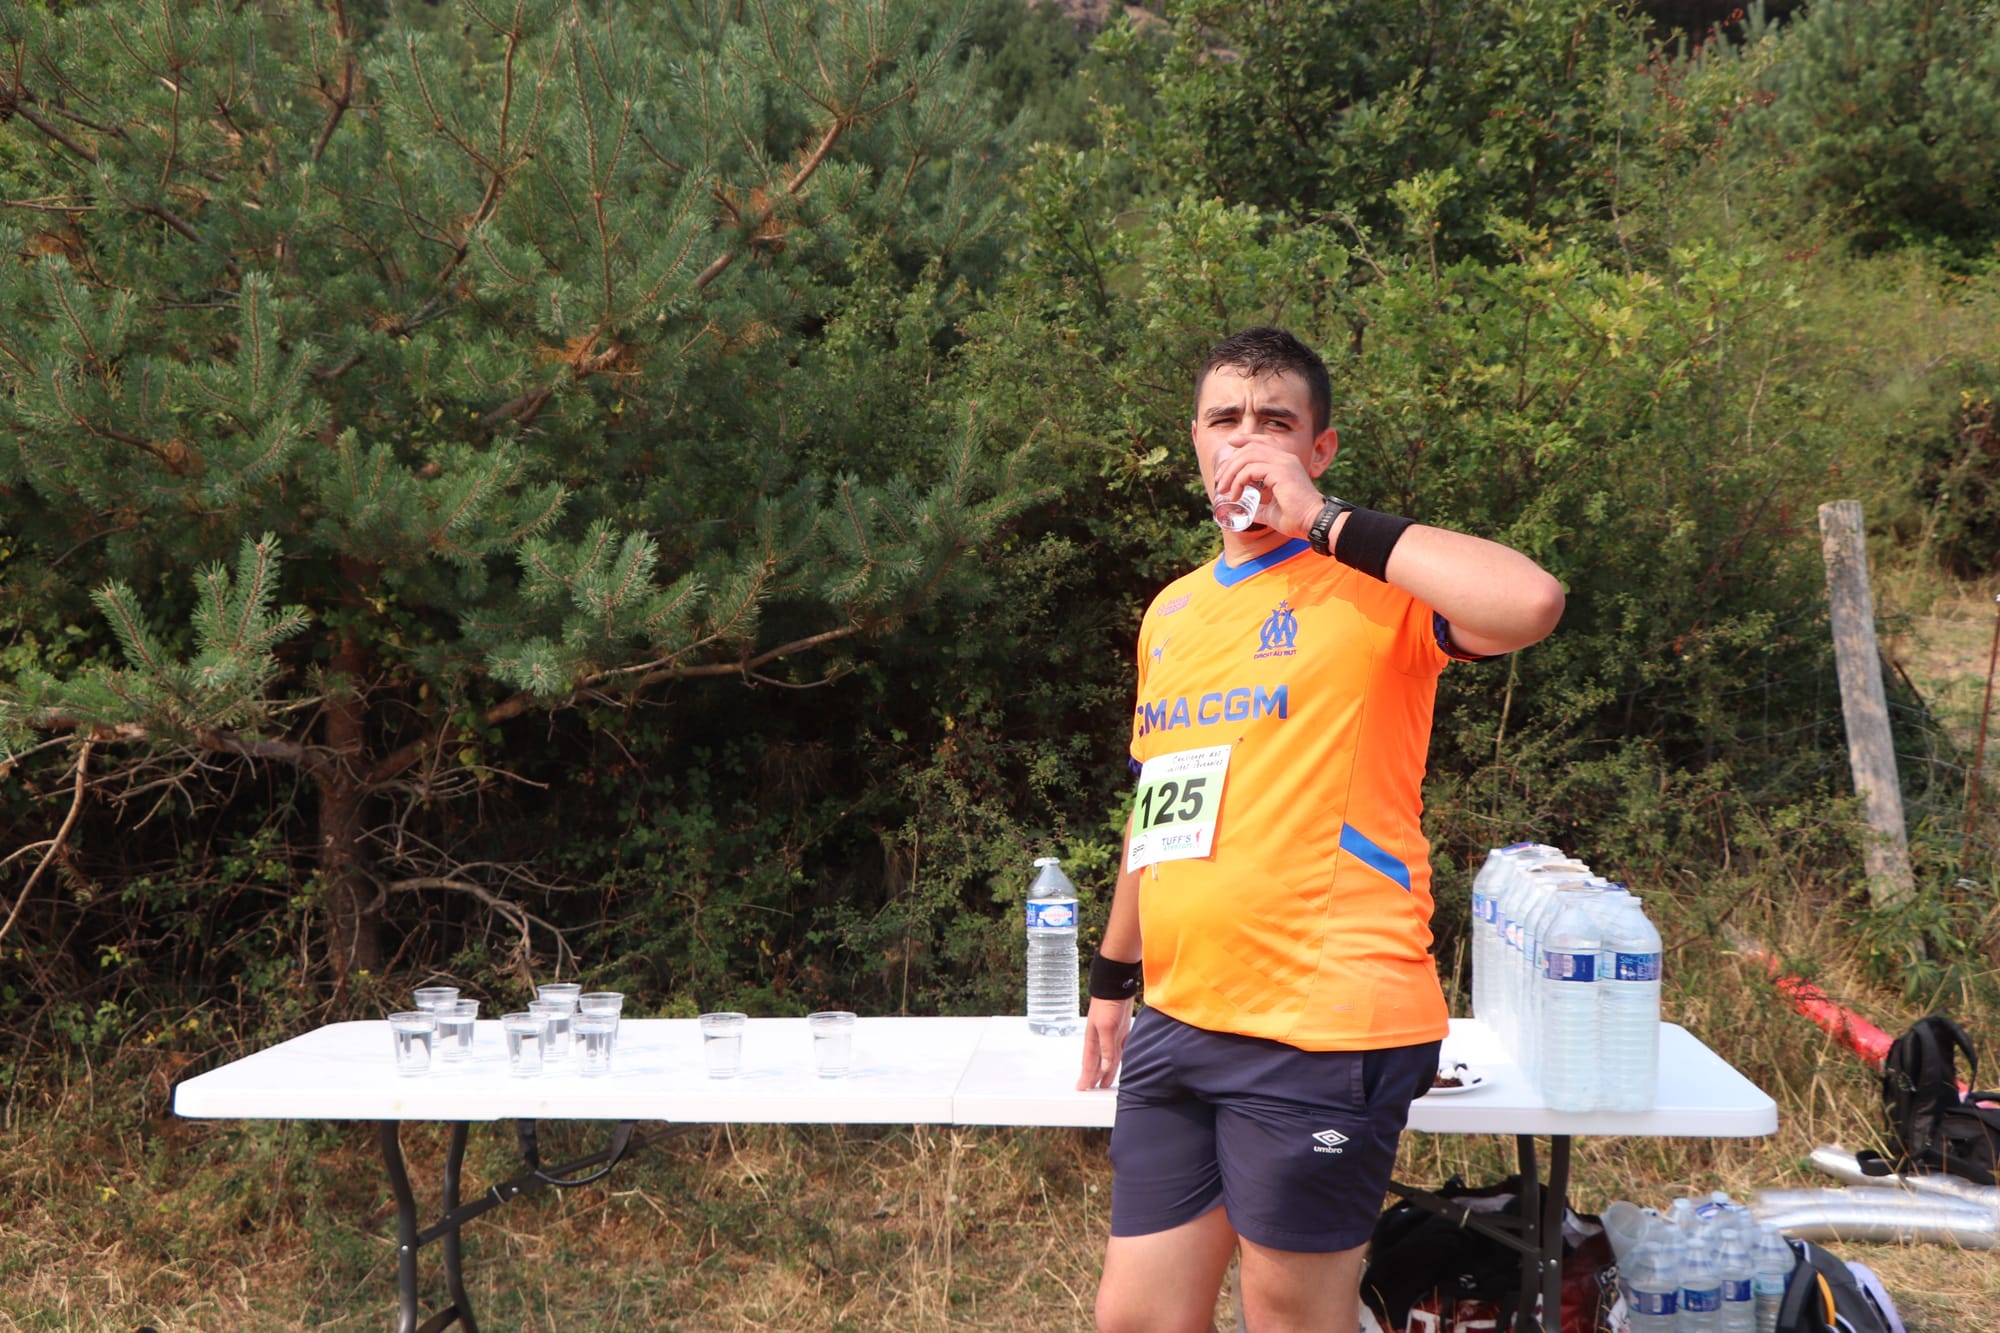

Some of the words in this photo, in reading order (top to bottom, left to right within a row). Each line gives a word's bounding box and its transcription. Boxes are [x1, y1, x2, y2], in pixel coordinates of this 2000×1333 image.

[1198, 685, 1288, 725] CGM
[1141, 778, 1207, 829] 125
[1161, 834, 1192, 846] TUFF'S
[1313, 1145, 1343, 1154] umbro
